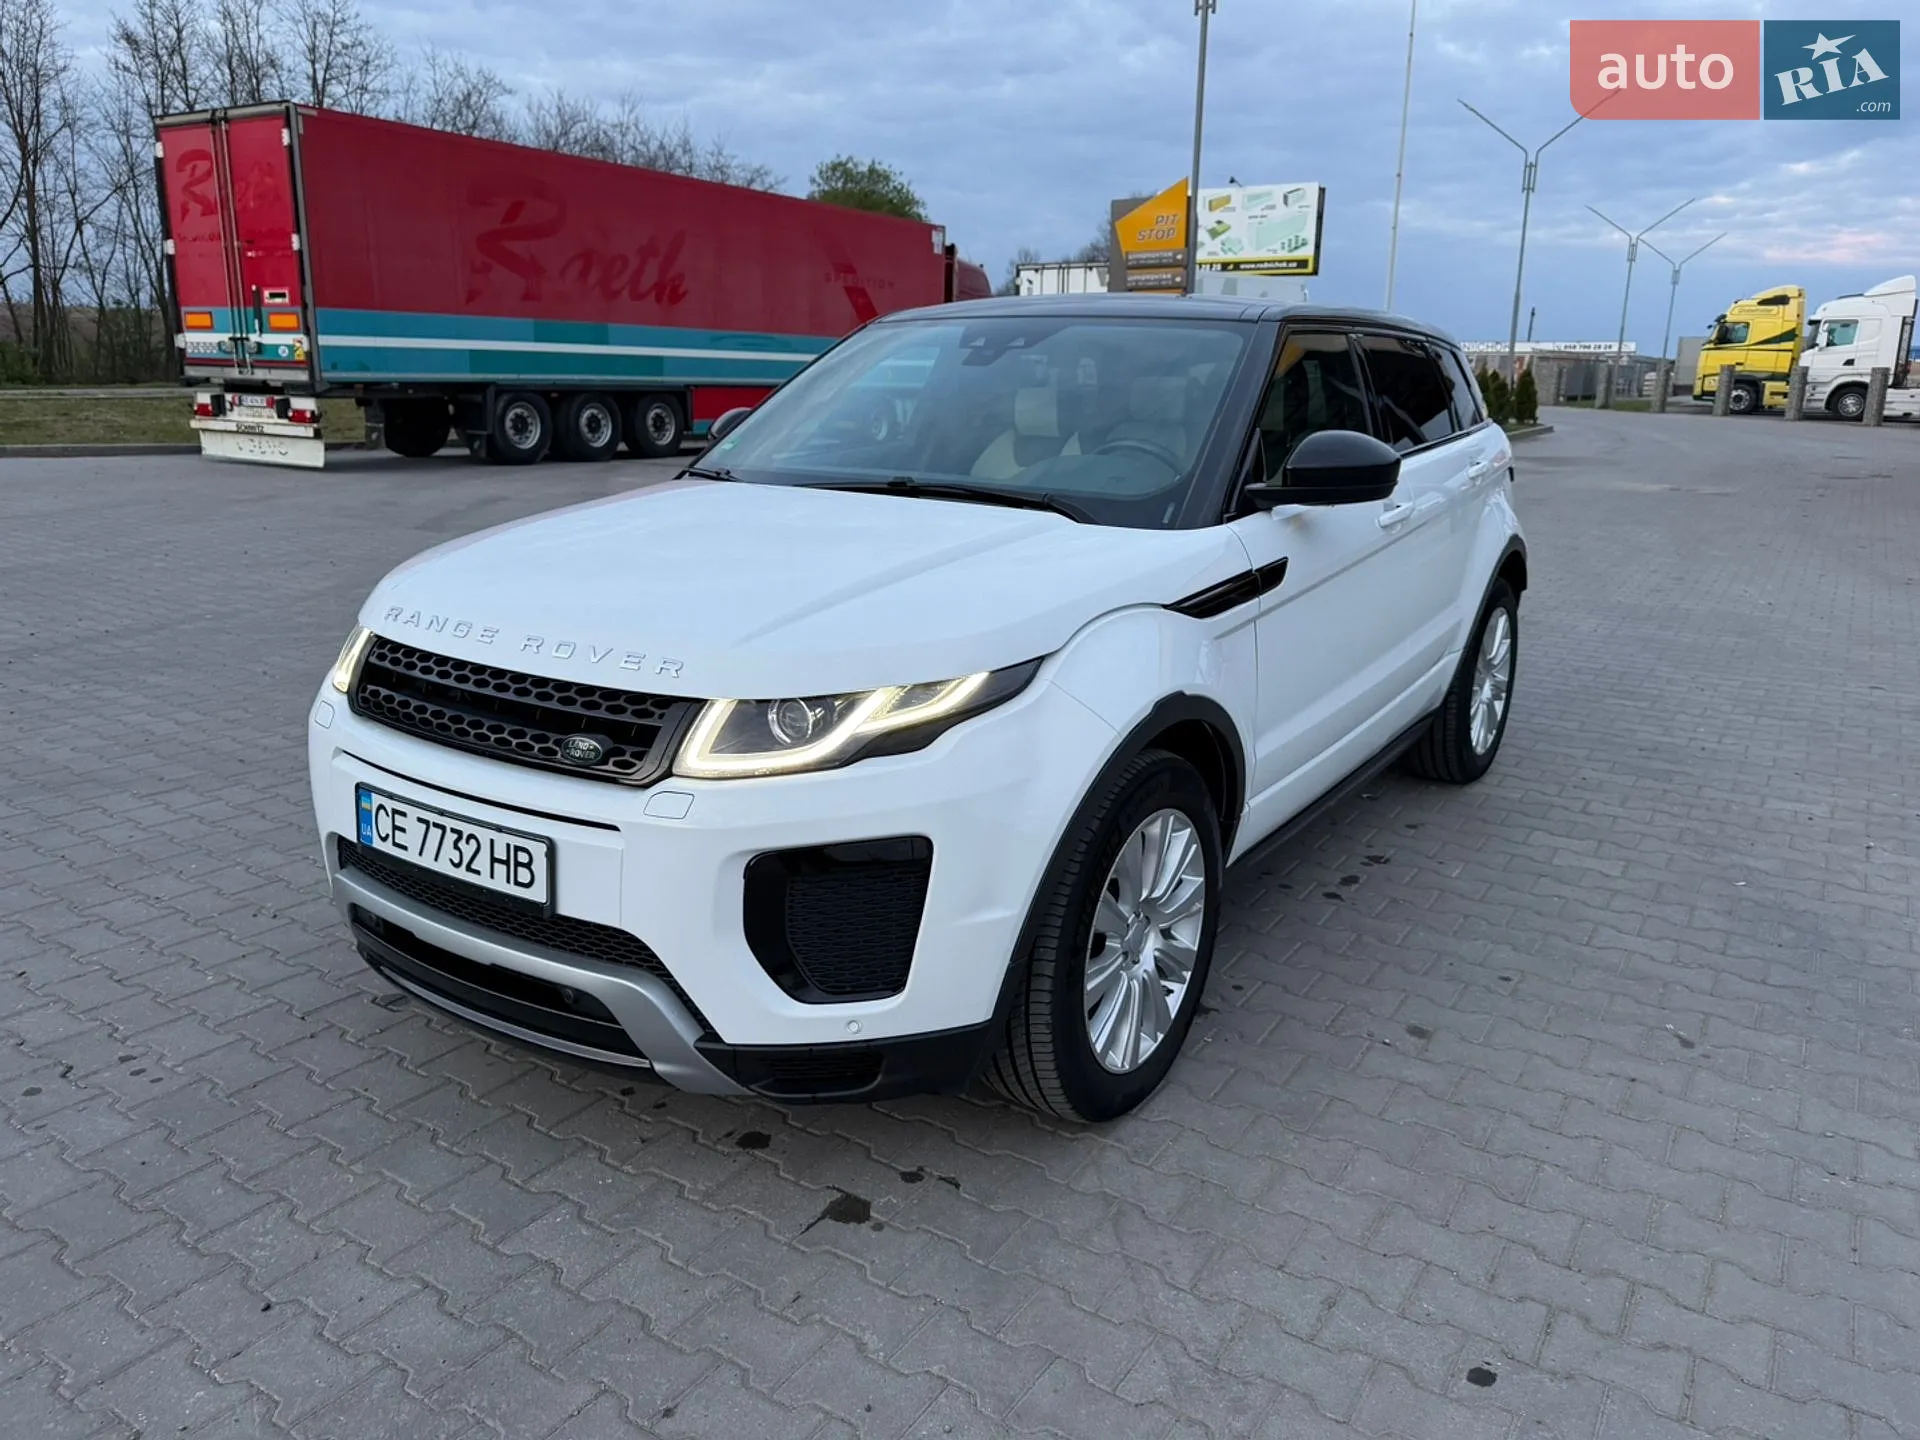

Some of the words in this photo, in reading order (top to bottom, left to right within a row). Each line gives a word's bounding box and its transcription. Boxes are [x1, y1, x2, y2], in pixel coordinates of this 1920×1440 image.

[1154, 213, 1178, 225] PIT
[1136, 227, 1176, 241] STOP
[383, 606, 500, 645] RANGE
[520, 634, 686, 679] ROVER
[361, 823, 372, 837] UA
[375, 803, 408, 851] CE
[416, 817, 481, 876] 7732
[489, 837, 536, 890] HB
